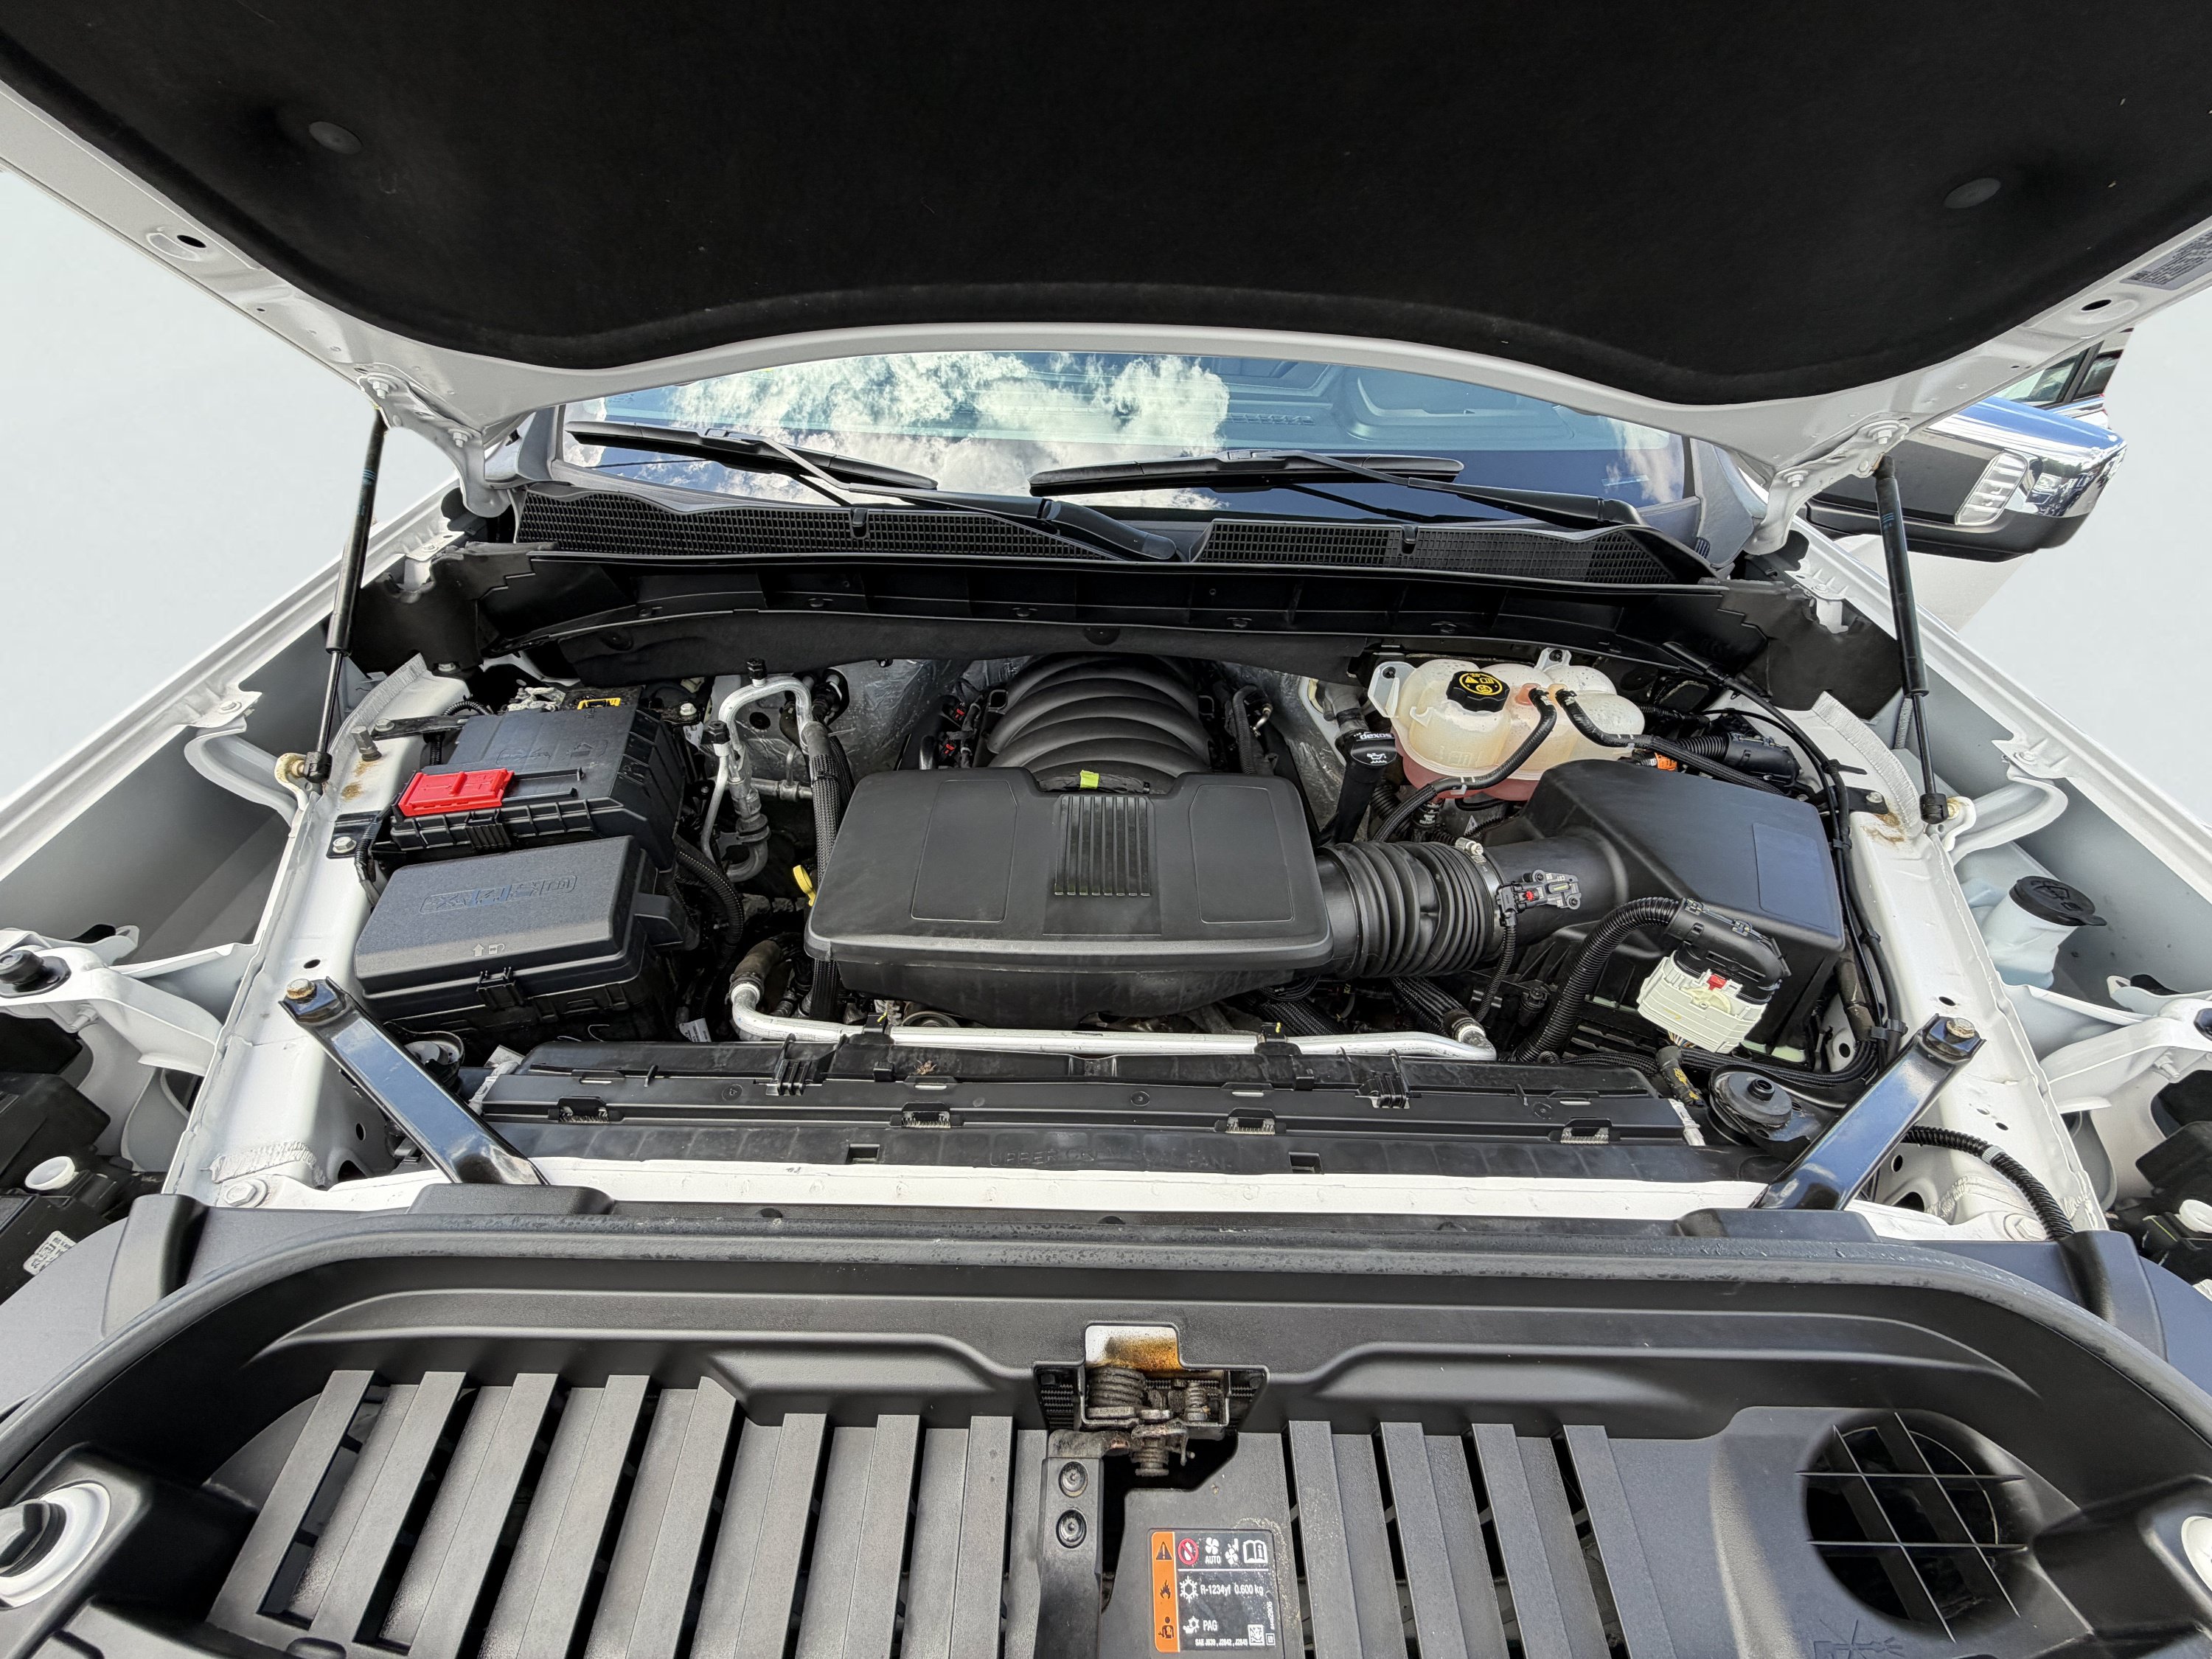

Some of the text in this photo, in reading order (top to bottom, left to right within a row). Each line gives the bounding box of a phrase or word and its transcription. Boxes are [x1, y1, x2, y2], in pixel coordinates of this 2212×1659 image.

[1205, 1555, 1222, 1564] AUTO
[1200, 1584, 1264, 1596] R-1234yf 0.600 kg
[1203, 1619, 1218, 1631] PAG
[1194, 1638, 1205, 1646] SAE
